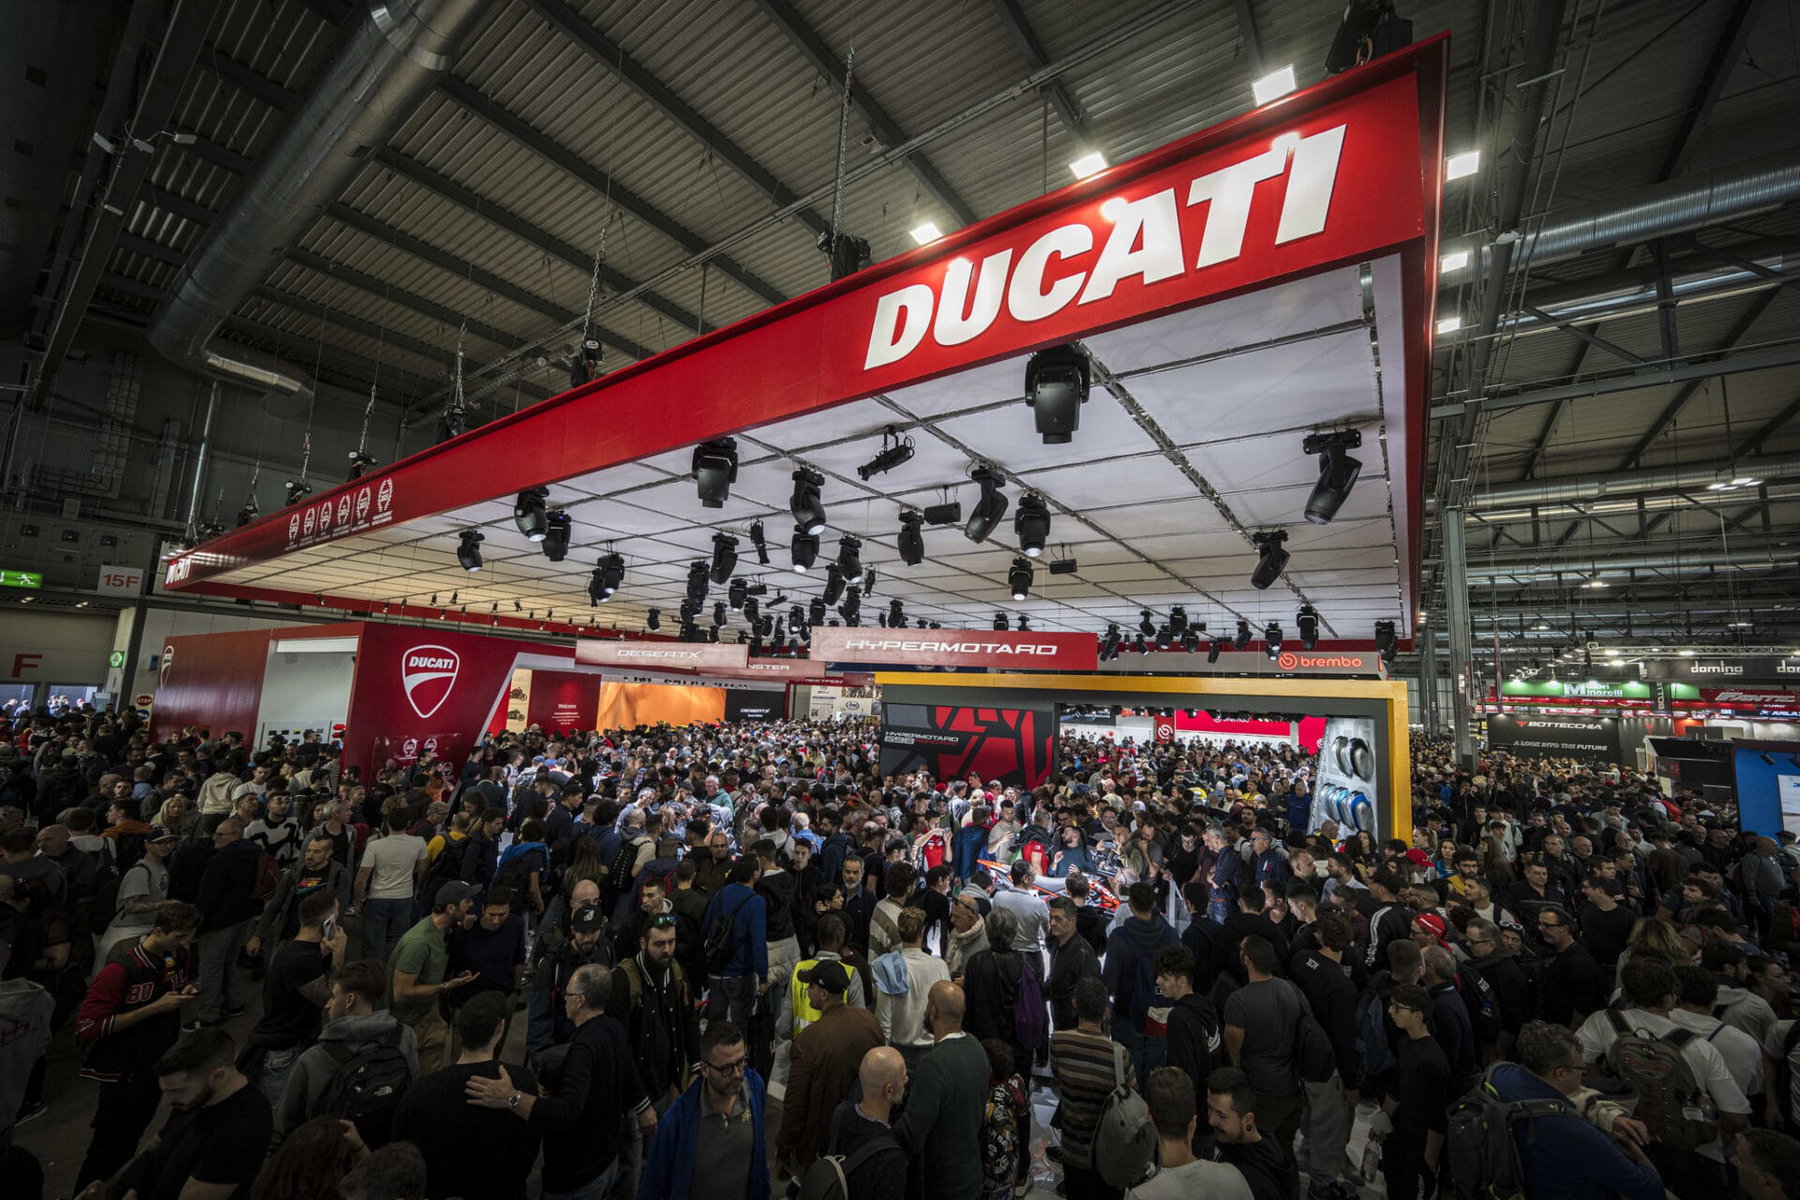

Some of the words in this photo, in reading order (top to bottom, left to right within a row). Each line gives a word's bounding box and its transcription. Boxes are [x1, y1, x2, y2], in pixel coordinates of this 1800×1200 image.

[864, 123, 1346, 370] DUCATI
[103, 573, 140, 588] 15F
[846, 639, 1057, 656] HYPERMOTARD
[617, 650, 702, 659] DESERTX
[12, 653, 43, 678] F
[409, 656, 455, 669] DUCATI
[1300, 656, 1362, 668] brembo
[1690, 660, 1744, 673] domino
[1528, 721, 1602, 730] BOTTECCHIA
[885, 731, 959, 743] HYPERMOTARD
